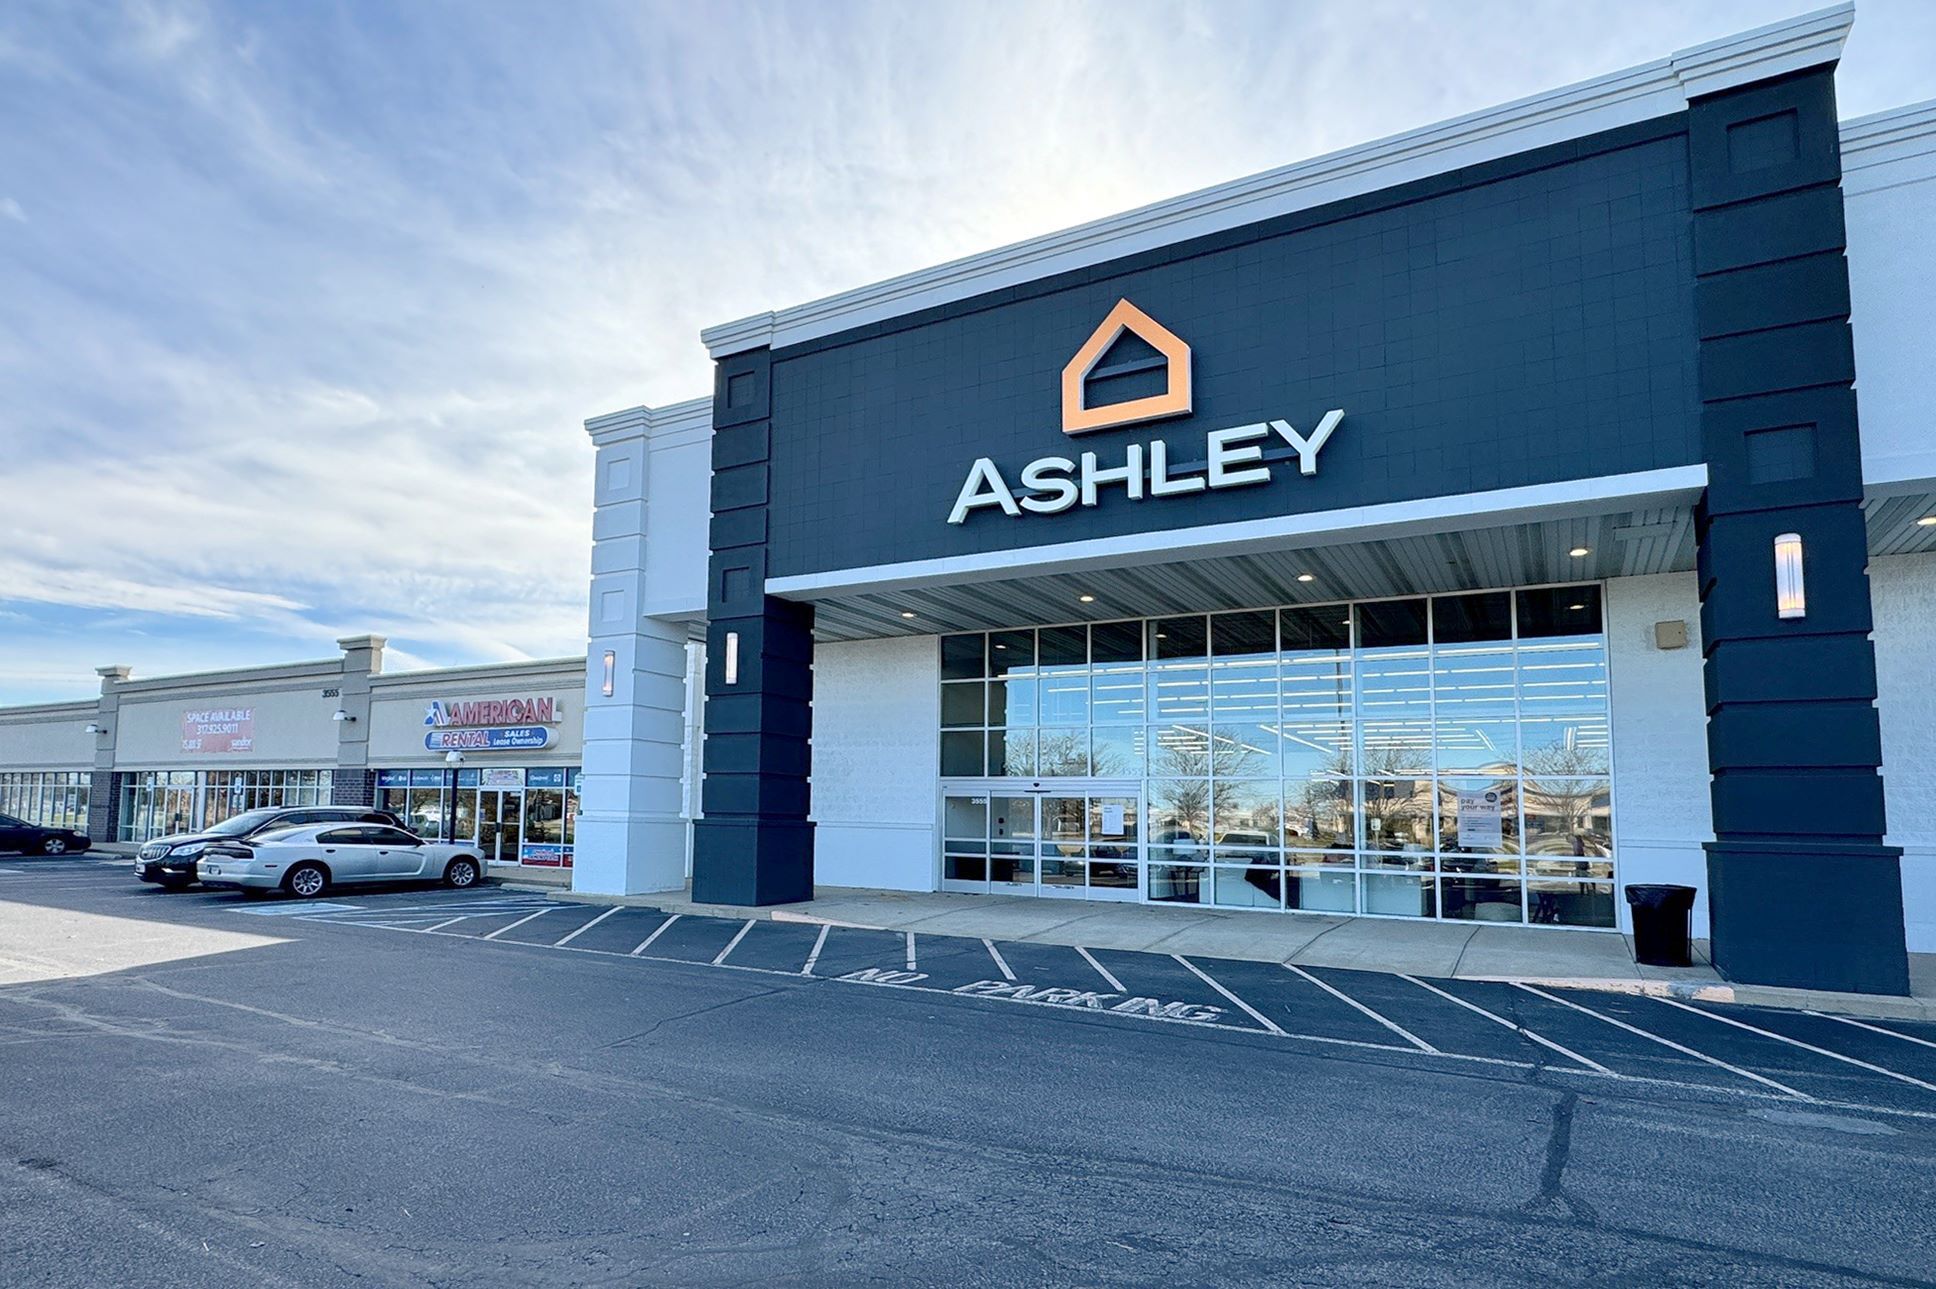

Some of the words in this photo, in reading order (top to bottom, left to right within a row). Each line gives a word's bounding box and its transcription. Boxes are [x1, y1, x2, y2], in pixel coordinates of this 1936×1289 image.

[947, 408, 1345, 525] ASHLEY
[187, 712, 209, 723] SPACE
[210, 710, 250, 721] AVAILABLE
[450, 697, 554, 726] AMERICAN
[440, 730, 491, 748] RENTAL
[493, 736, 510, 746] Lease
[511, 735, 544, 747] Ownership
[504, 729, 531, 738] SALES
[838, 967, 929, 985] NO
[952, 979, 1228, 1022] PARKING
